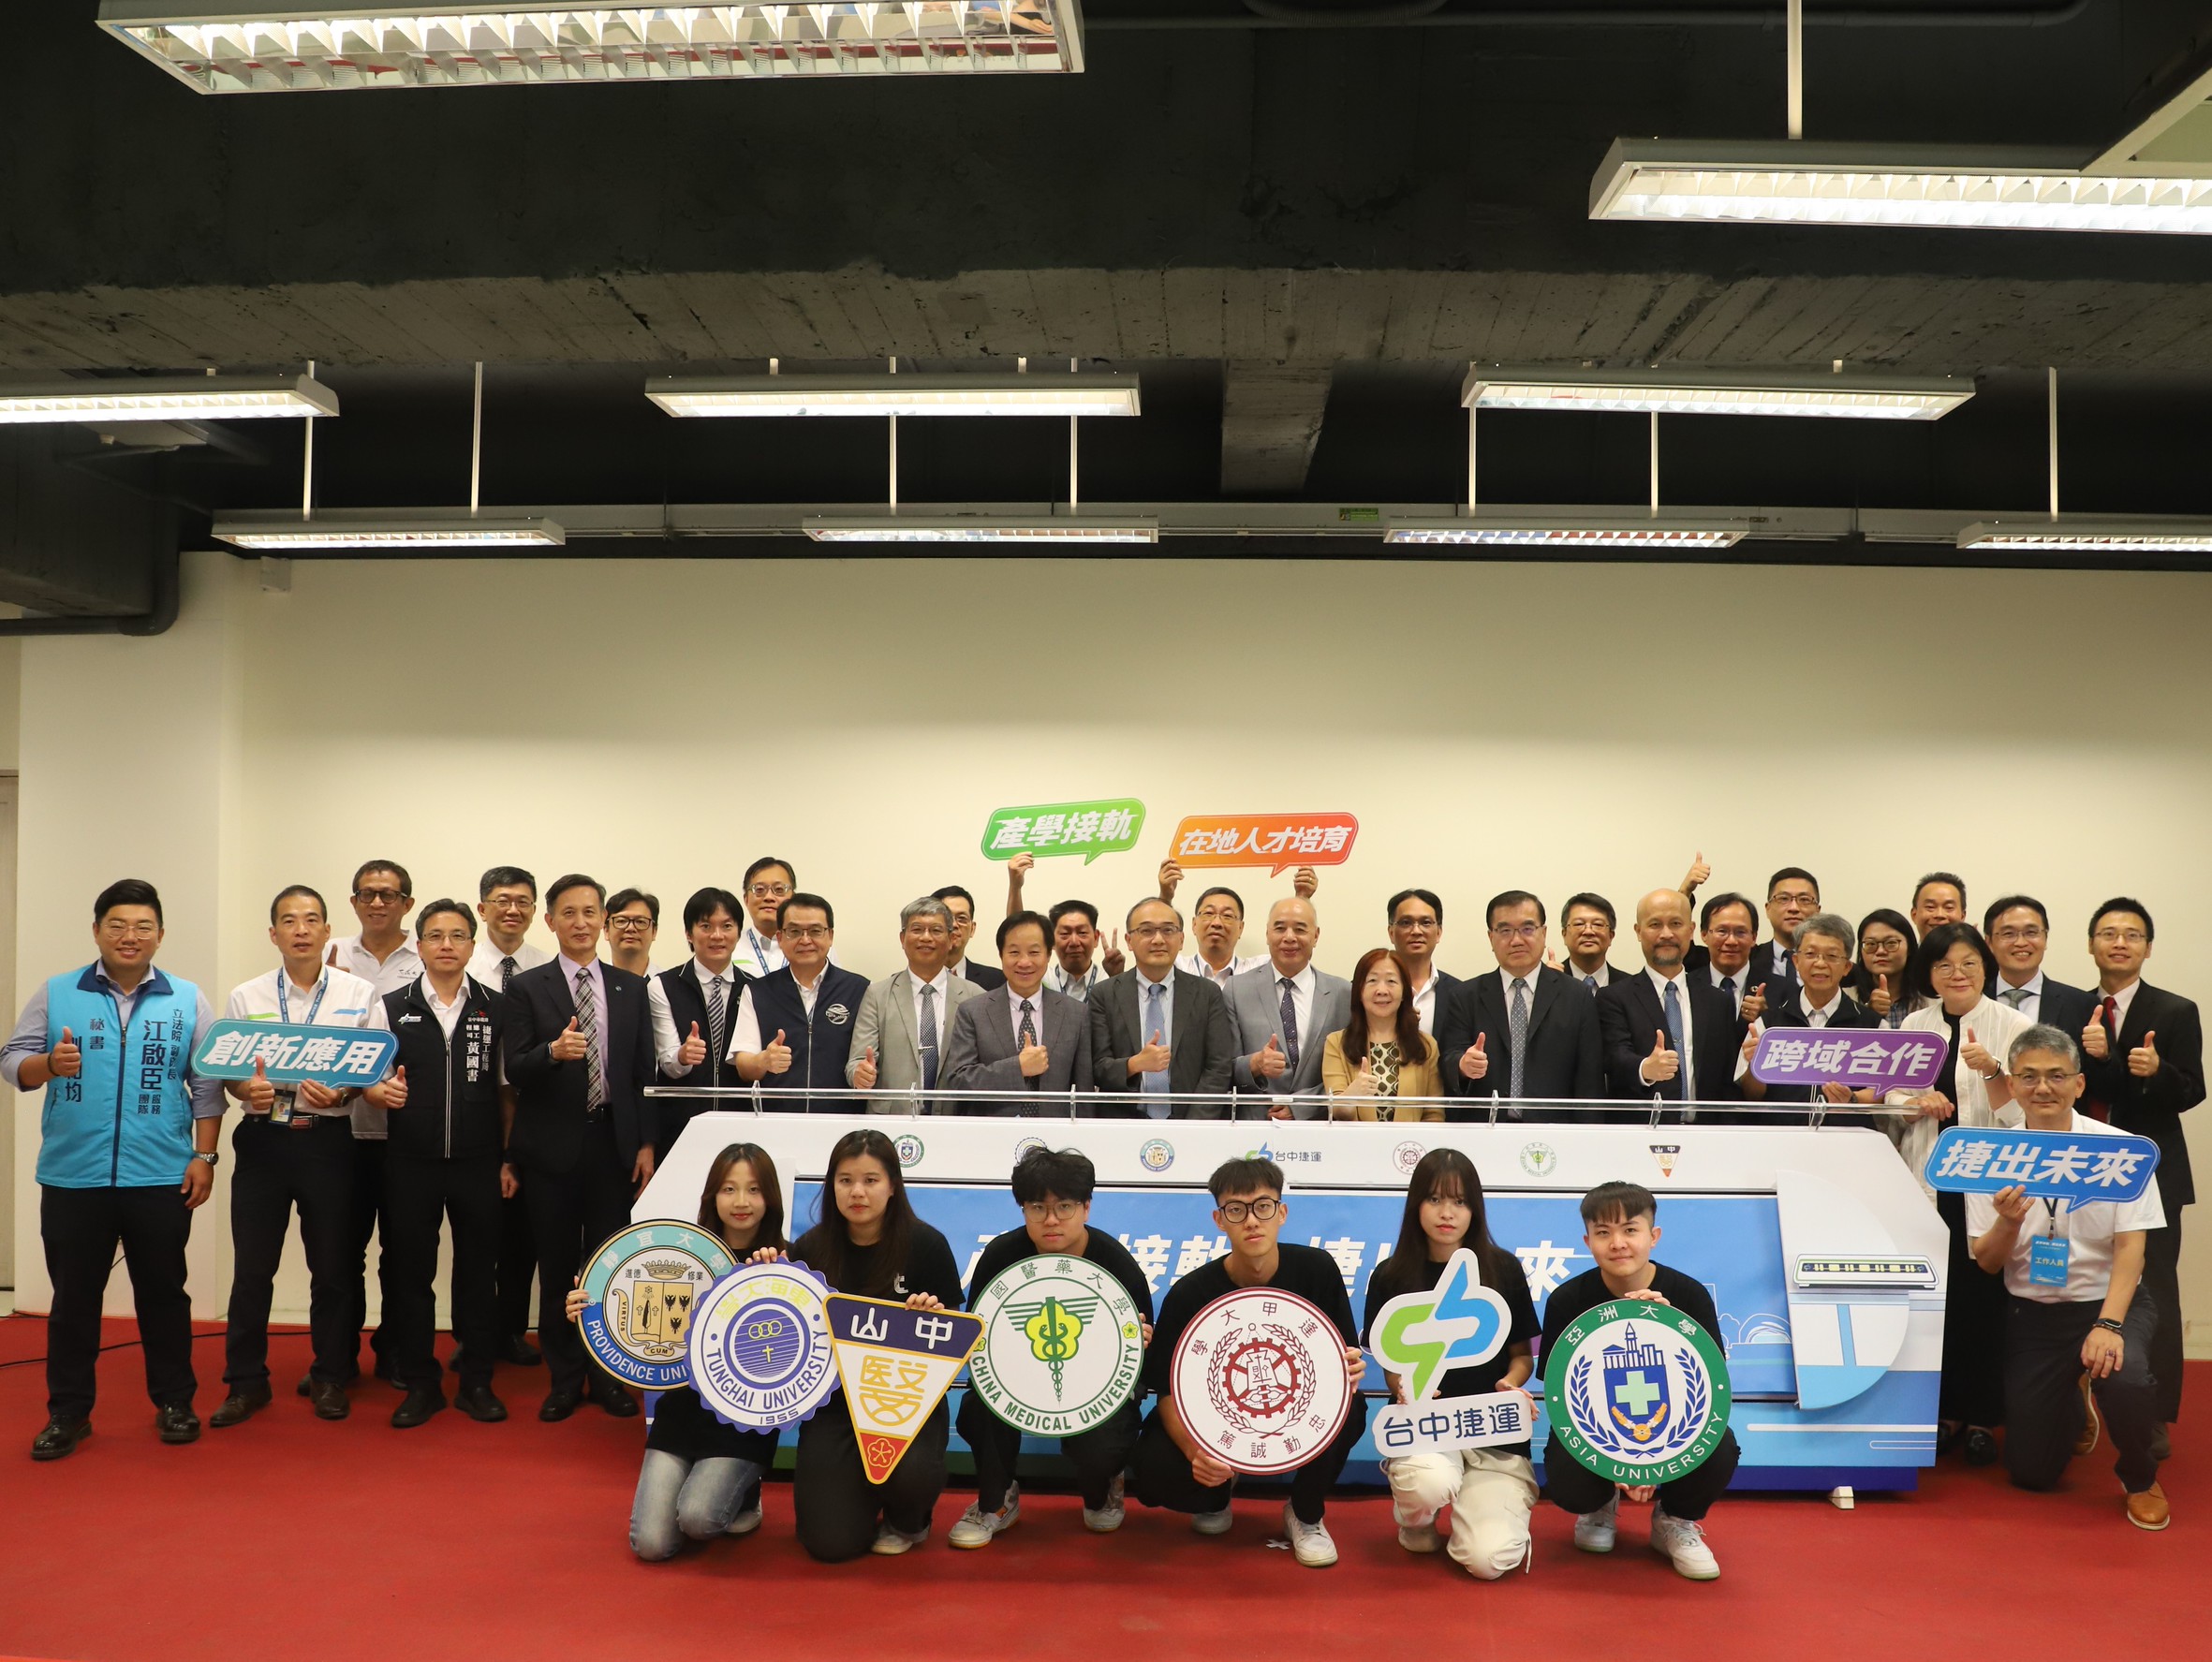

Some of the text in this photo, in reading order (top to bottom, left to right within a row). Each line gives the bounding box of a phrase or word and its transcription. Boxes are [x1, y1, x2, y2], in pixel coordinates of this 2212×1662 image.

[991, 809, 1138, 849] 產學接軌
[1178, 825, 1352, 857] 在地人才培育
[90, 1018, 105, 1050] 秘書
[201, 1031, 387, 1074] 創新應用
[1759, 1039, 1939, 1077] 跨域合作
[1276, 1151, 1322, 1162] 台中捷運
[1936, 1140, 2151, 1188] 捷出未來
[625, 1268, 641, 1279] 進德
[978, 1259, 1130, 1323] 國醫藥大學
[619, 1301, 627, 1331] VIRTUS
[1565, 1305, 1697, 1346] 亞洲大學
[587, 1319, 687, 1381] PROVIDENCE UNI
[707, 1331, 829, 1409] TUNGHAI UNIVERSITY
[972, 1345, 1139, 1431] CHINA MEDICAL UNIVERSITY
[759, 1408, 799, 1425] 1955
[1383, 1403, 1522, 1447] 台中捷運
[1560, 1412, 1723, 1479] ASIA UNIVERSITY
